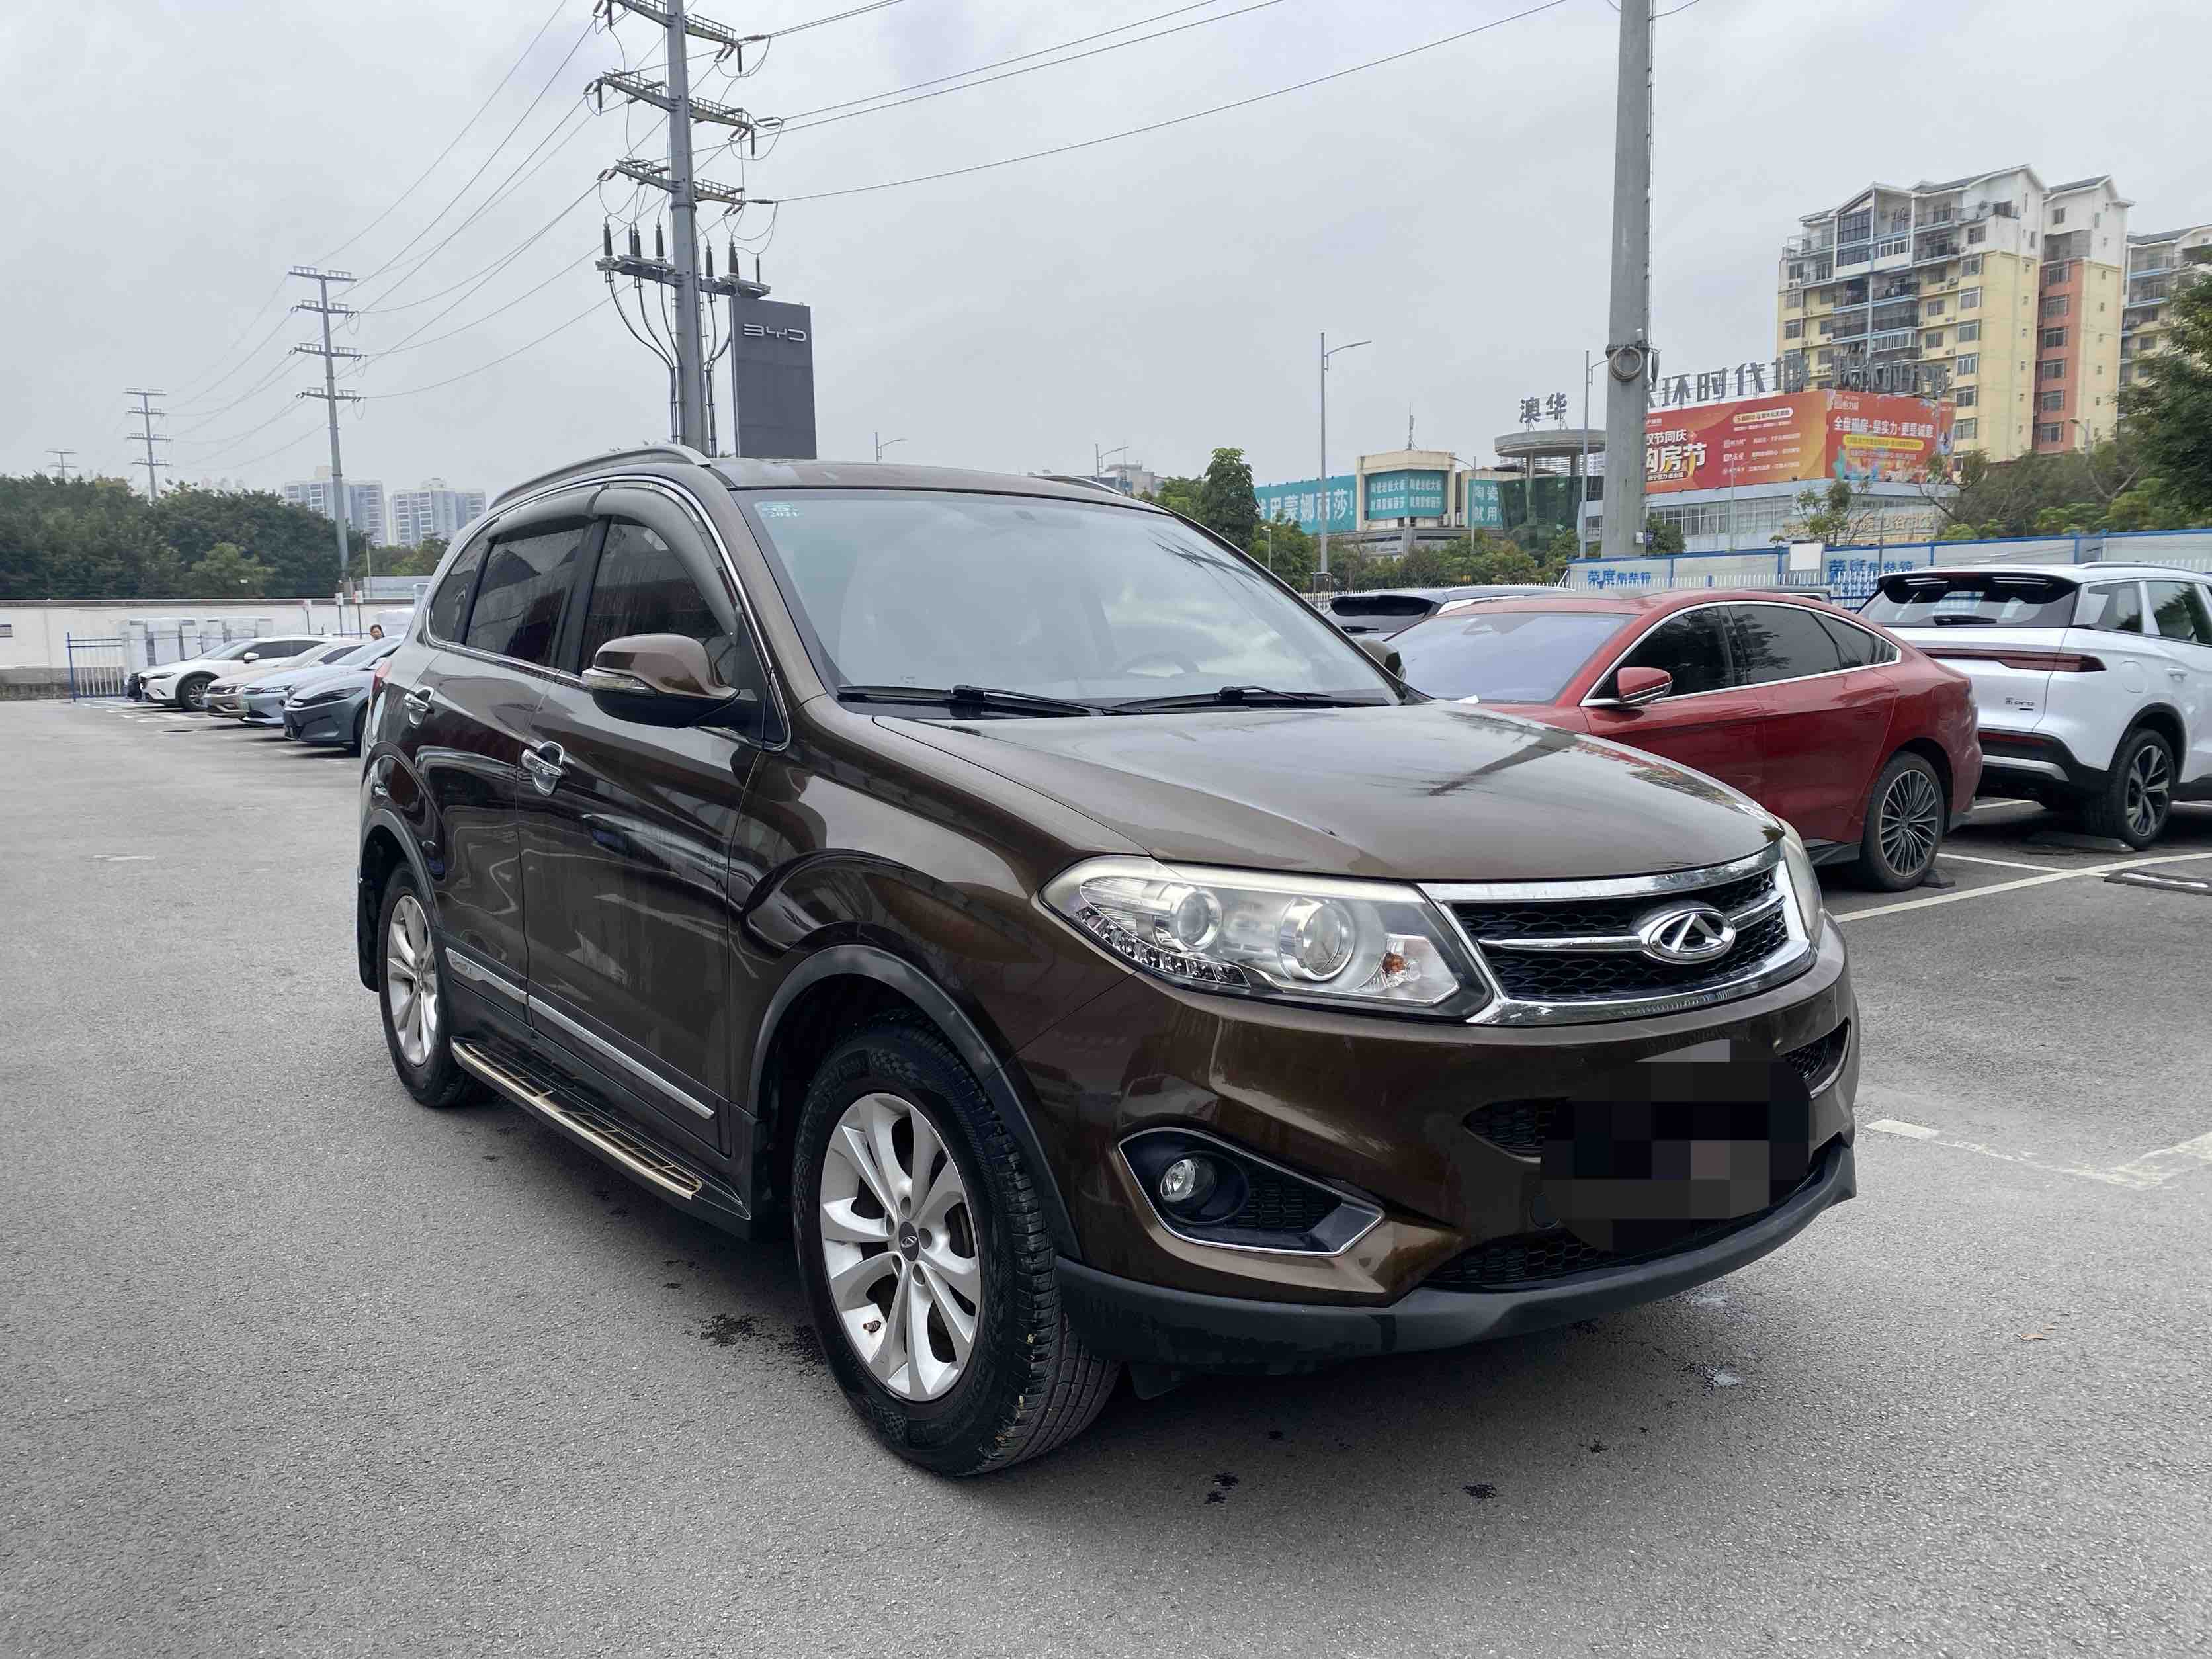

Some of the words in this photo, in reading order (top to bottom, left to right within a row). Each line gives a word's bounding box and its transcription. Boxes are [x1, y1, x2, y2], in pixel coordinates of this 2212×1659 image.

[744, 323, 807, 341] BYD
[1646, 354, 1811, 408] 环时代城
[1519, 392, 1567, 423] 澳华
